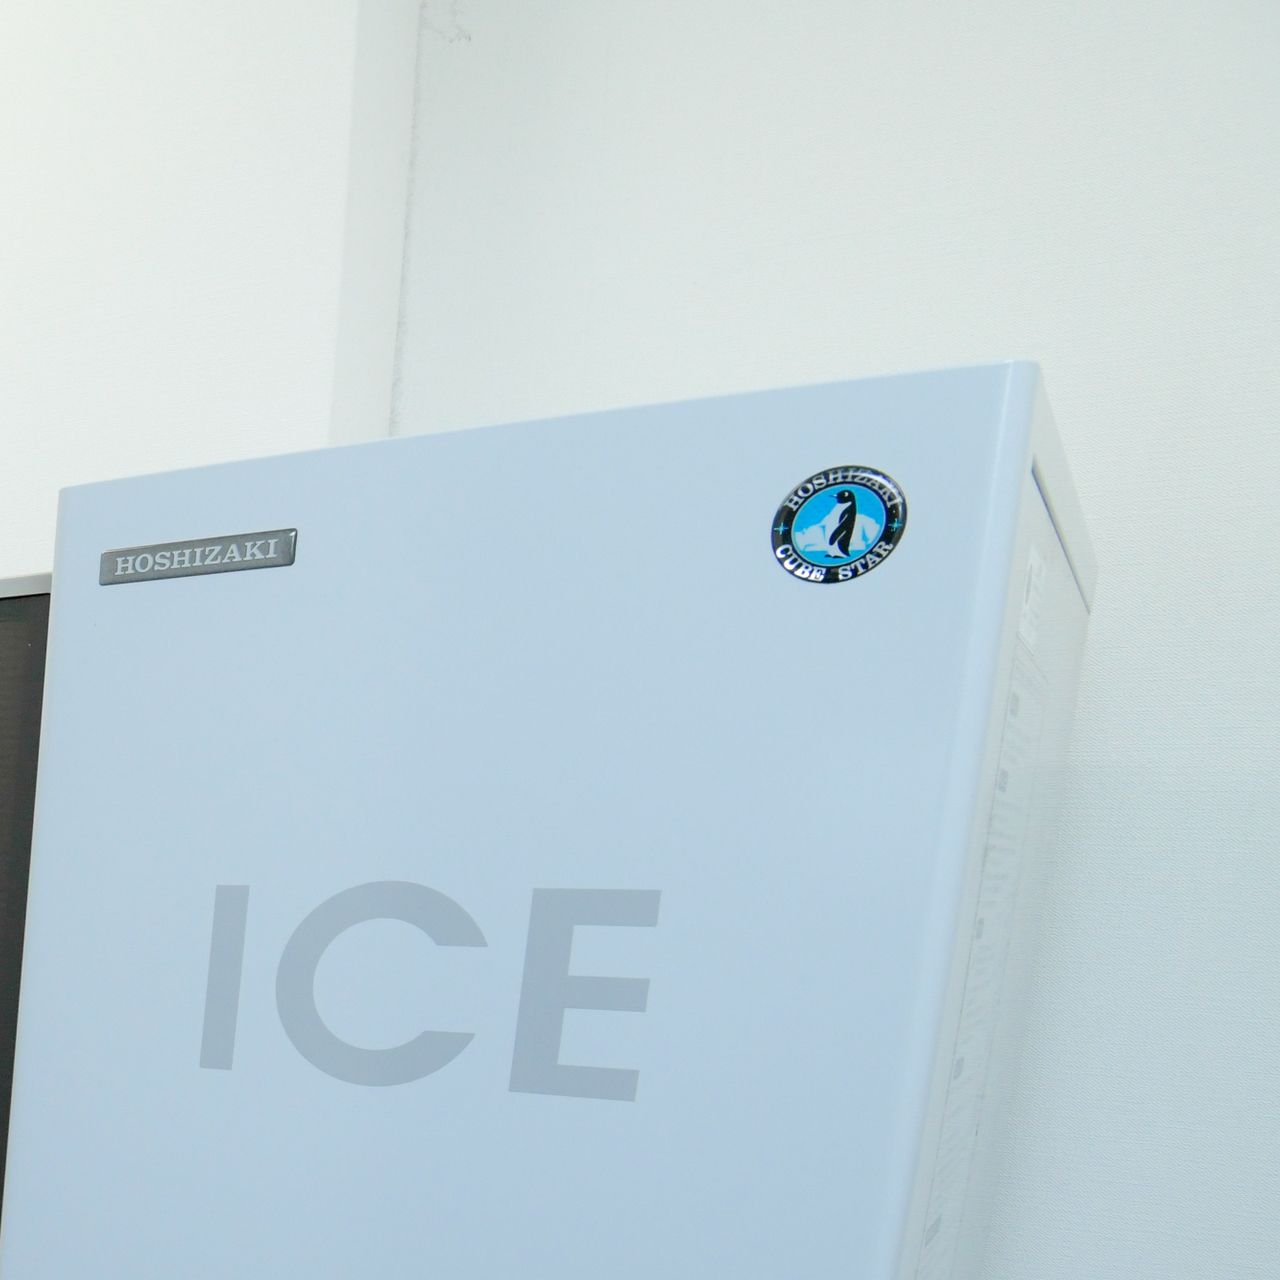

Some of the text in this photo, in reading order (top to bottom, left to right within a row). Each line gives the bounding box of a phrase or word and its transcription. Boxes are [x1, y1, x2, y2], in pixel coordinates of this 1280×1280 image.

[115, 539, 279, 576] HOSHIZAKI
[776, 541, 893, 582] CUBE STAR
[199, 880, 662, 1103] ICE
